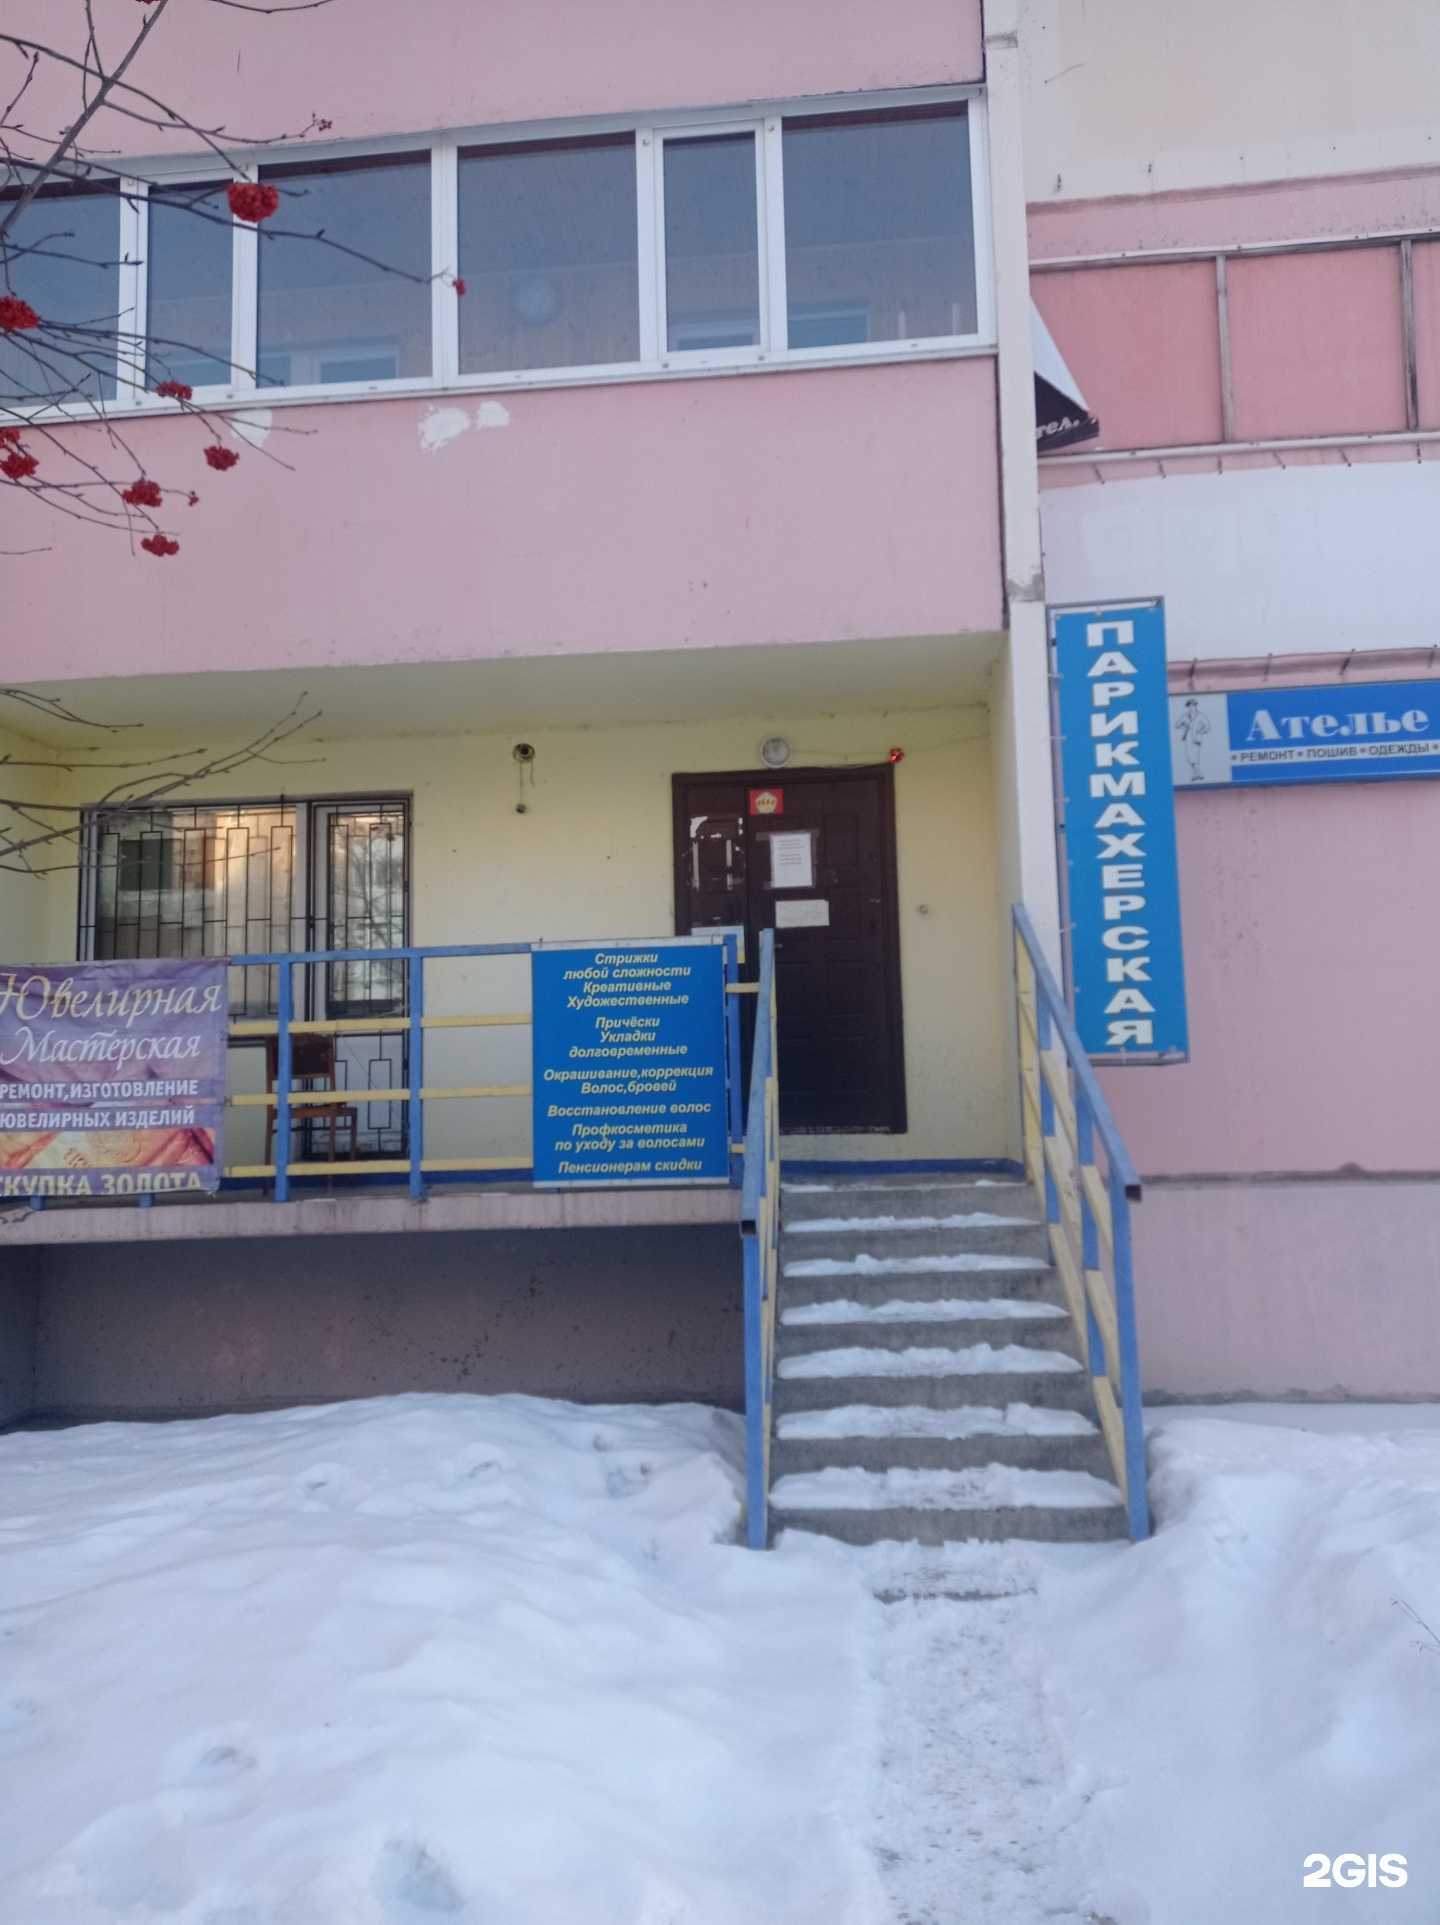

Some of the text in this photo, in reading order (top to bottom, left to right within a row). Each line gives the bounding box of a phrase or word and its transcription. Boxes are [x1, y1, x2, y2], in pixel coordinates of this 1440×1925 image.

[1245, 709, 1430, 742] Ателье
[1240, 743, 1430, 762] РЕМОНТ ПОШИВ ОДЕЖДЫ
[1085, 620, 1156, 1046] ПАРИКМАХЕРСКАЯ
[594, 952, 658, 965] Стрижки
[563, 966, 691, 981] любой сложности
[583, 980, 672, 995] Креативные
[0, 973, 223, 1028] Ювелирная
[567, 995, 689, 1010] Художественные
[595, 1016, 660, 1030] Причёски
[600, 1031, 656, 1044] Укладки
[0, 1026, 202, 1071] Мастерская
[569, 1045, 688, 1059] долговременные
[543, 1066, 714, 1081] Окрашивание,коррекция
[0, 1079, 199, 1101] РЕМОНТ,ИЗГОТОВЛЕНИЕ
[580, 1080, 677, 1095] Волос,бровей
[0, 1106, 195, 1129] ЮВЕЛИРНЫХ ИЗДЕЛИЙ
[547, 1103, 711, 1118] Восстановление волос
[572, 1123, 688, 1138] Профкосметика
[554, 1137, 705, 1154] по уходу за волосами
[558, 1159, 702, 1175] Пенсионерам скидки
[0, 1172, 202, 1197] КУПКА ЗОЛОТА
